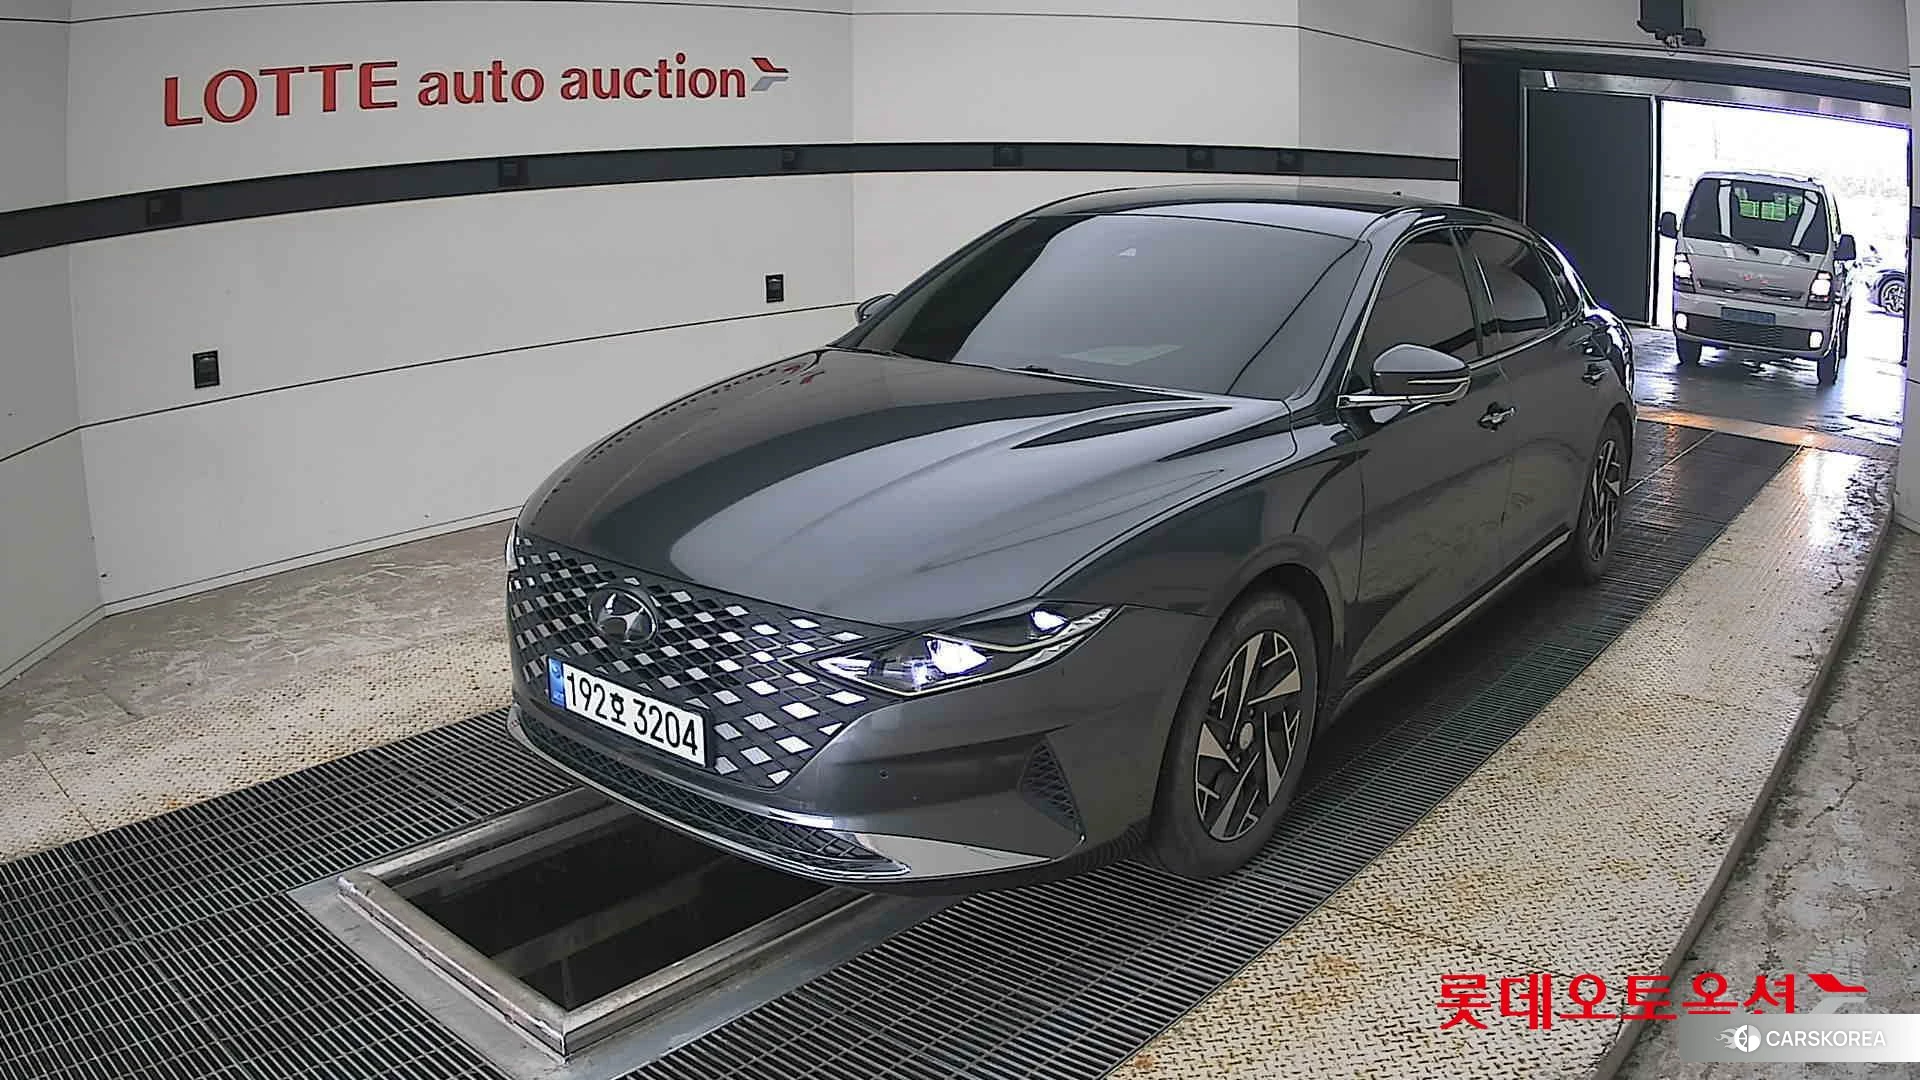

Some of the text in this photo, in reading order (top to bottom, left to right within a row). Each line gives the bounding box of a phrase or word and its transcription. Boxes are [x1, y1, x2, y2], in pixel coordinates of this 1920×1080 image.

[164, 52, 746, 126] LOTTE auto auction
[566, 672, 698, 756] 192호 3204
